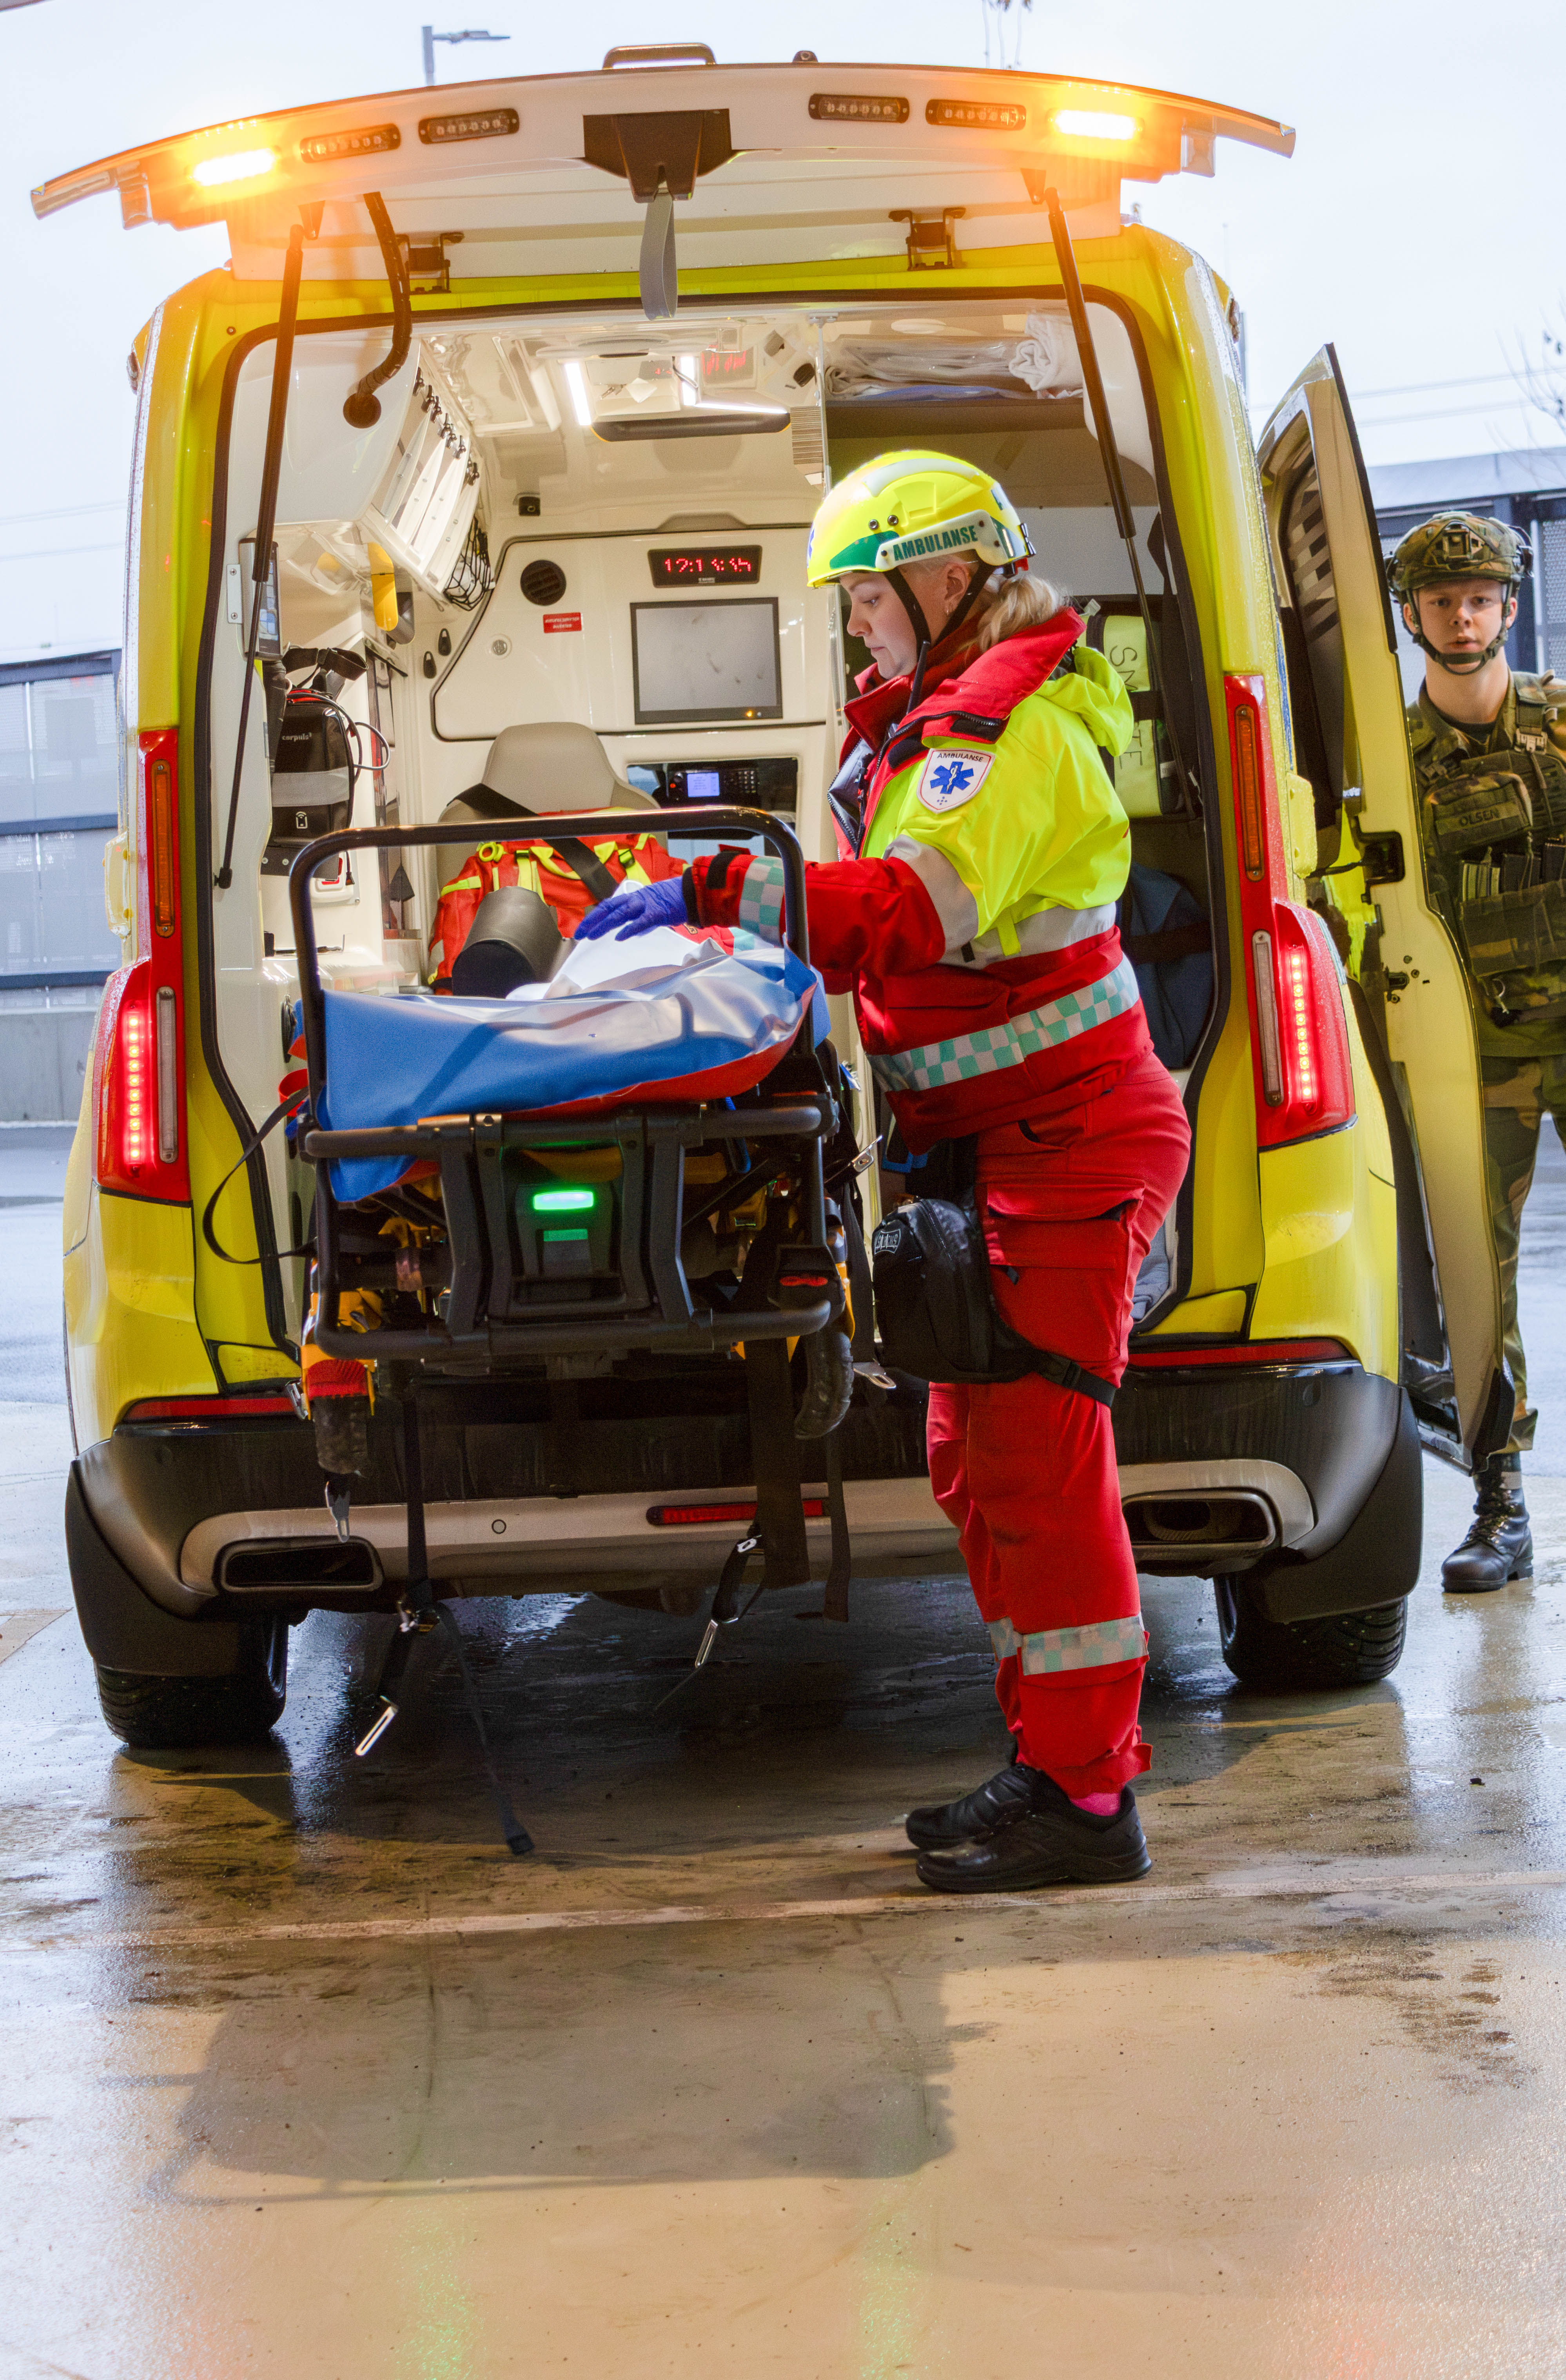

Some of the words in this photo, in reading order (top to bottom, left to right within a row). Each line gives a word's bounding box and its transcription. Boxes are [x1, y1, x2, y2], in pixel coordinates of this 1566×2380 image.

[893, 525, 978, 561] AMBULANSE
[937, 753, 984, 762] AMBULANSE
[1461, 808, 1500, 826] OLSEN
